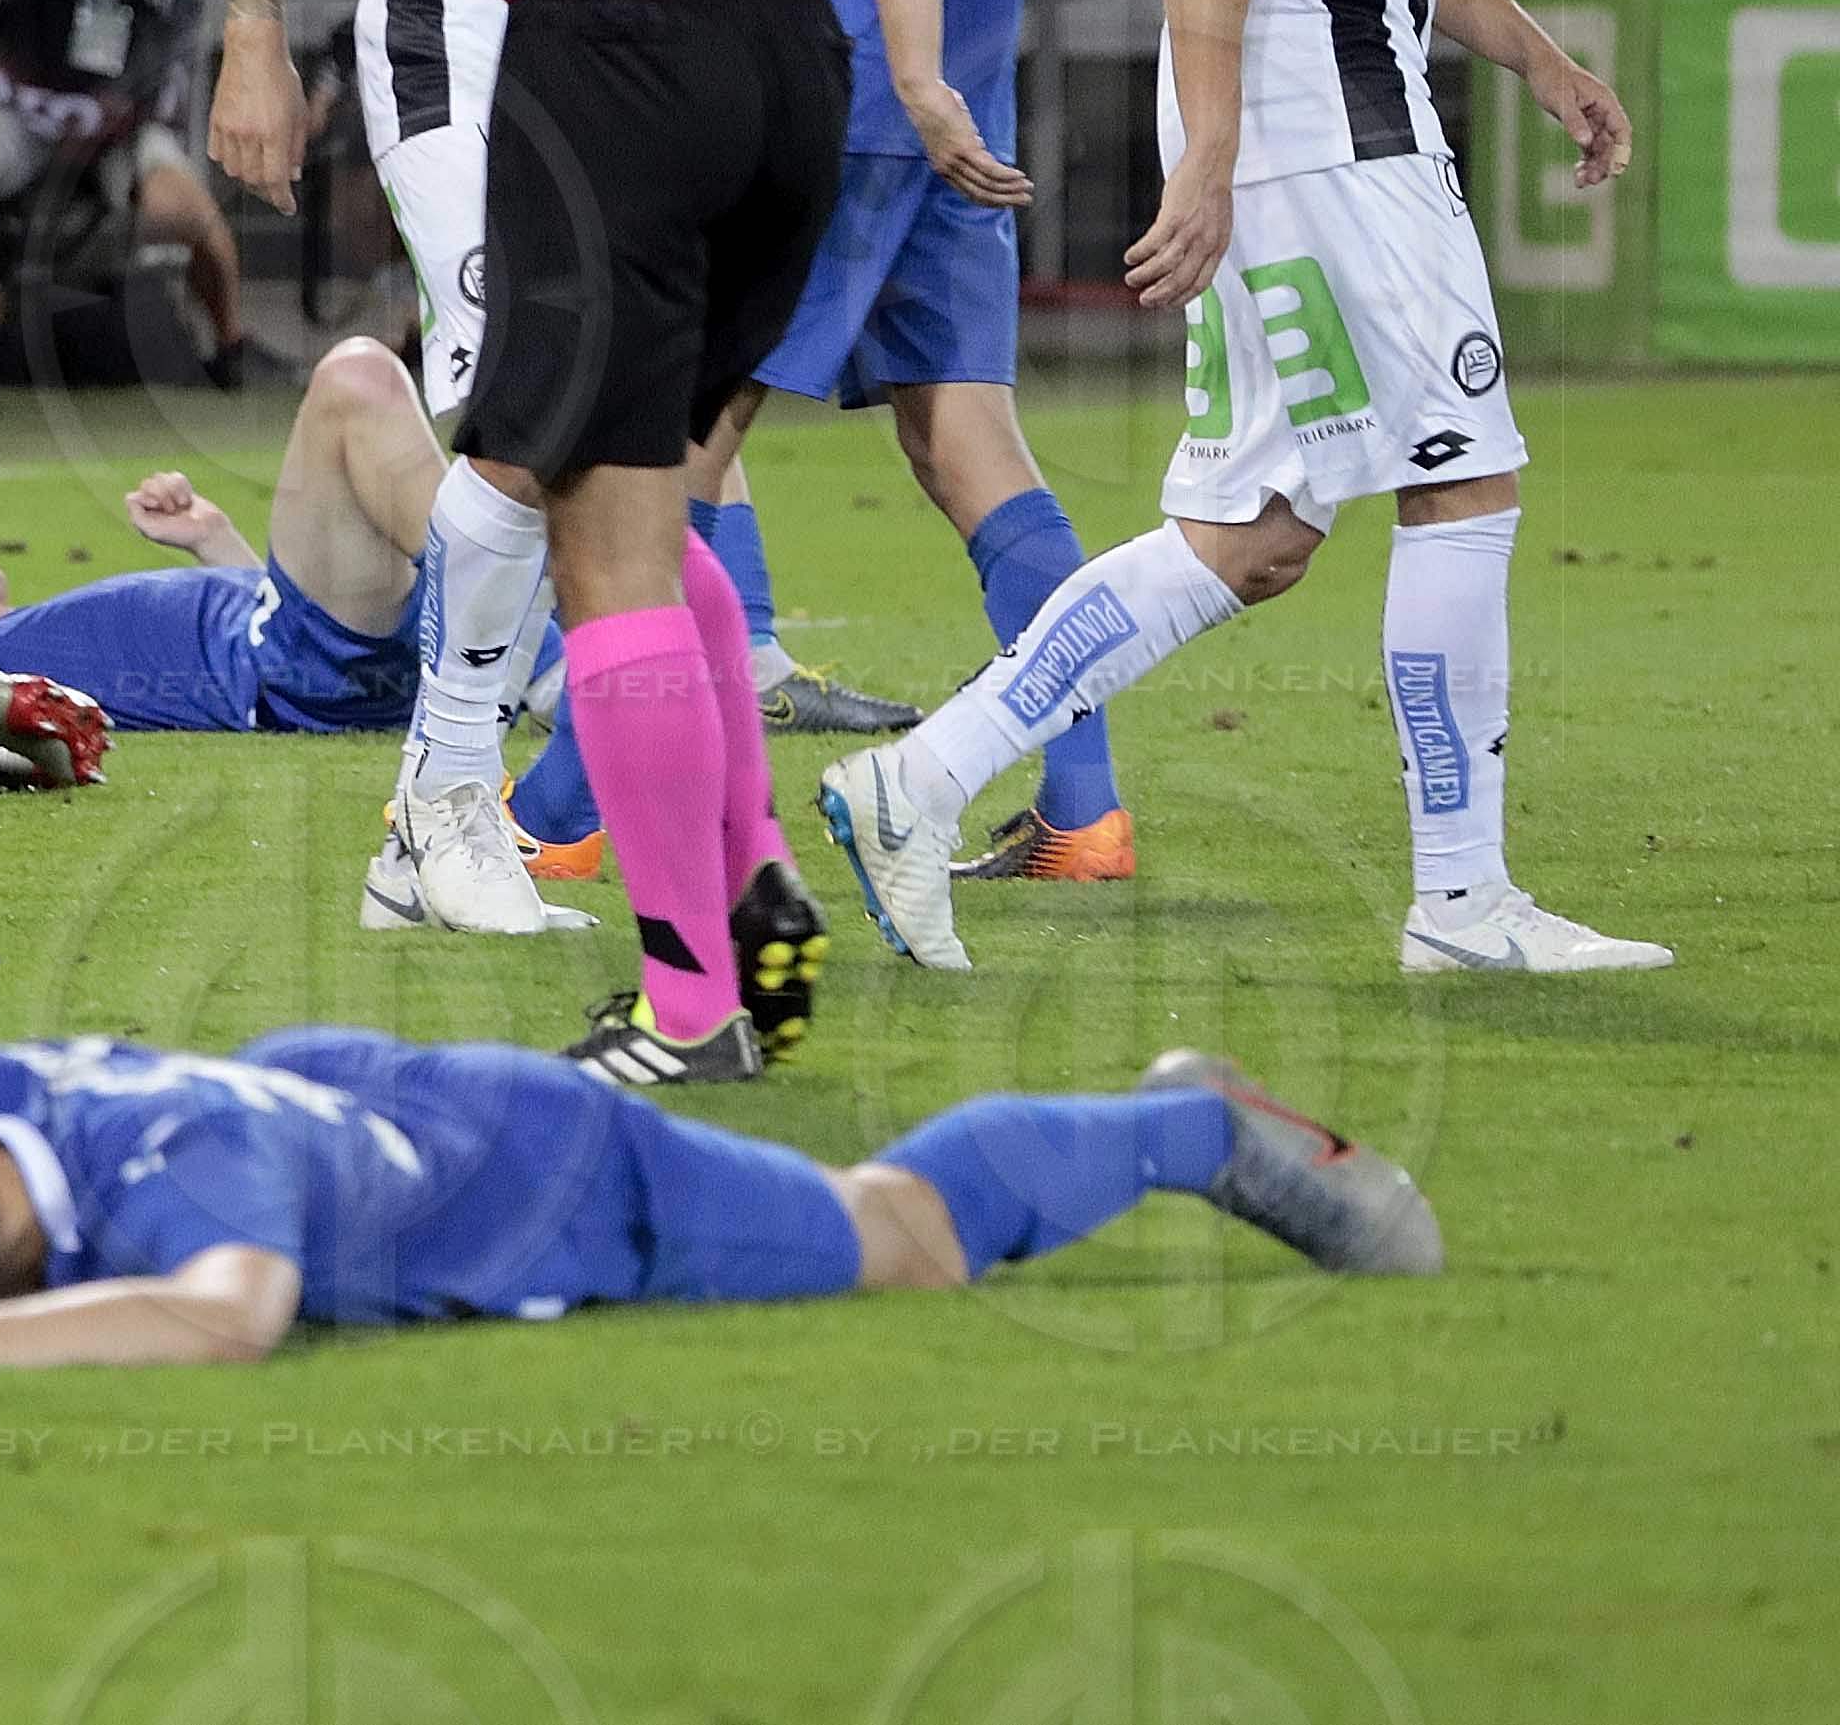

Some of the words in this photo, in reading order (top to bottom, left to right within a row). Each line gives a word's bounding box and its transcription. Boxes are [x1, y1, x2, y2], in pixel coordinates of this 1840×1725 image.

[1294, 417, 1377, 446] TEIERMARK
[1009, 591, 1130, 719] PUNTIGAMER
[1397, 660, 1463, 807] PUNTIGAMER
